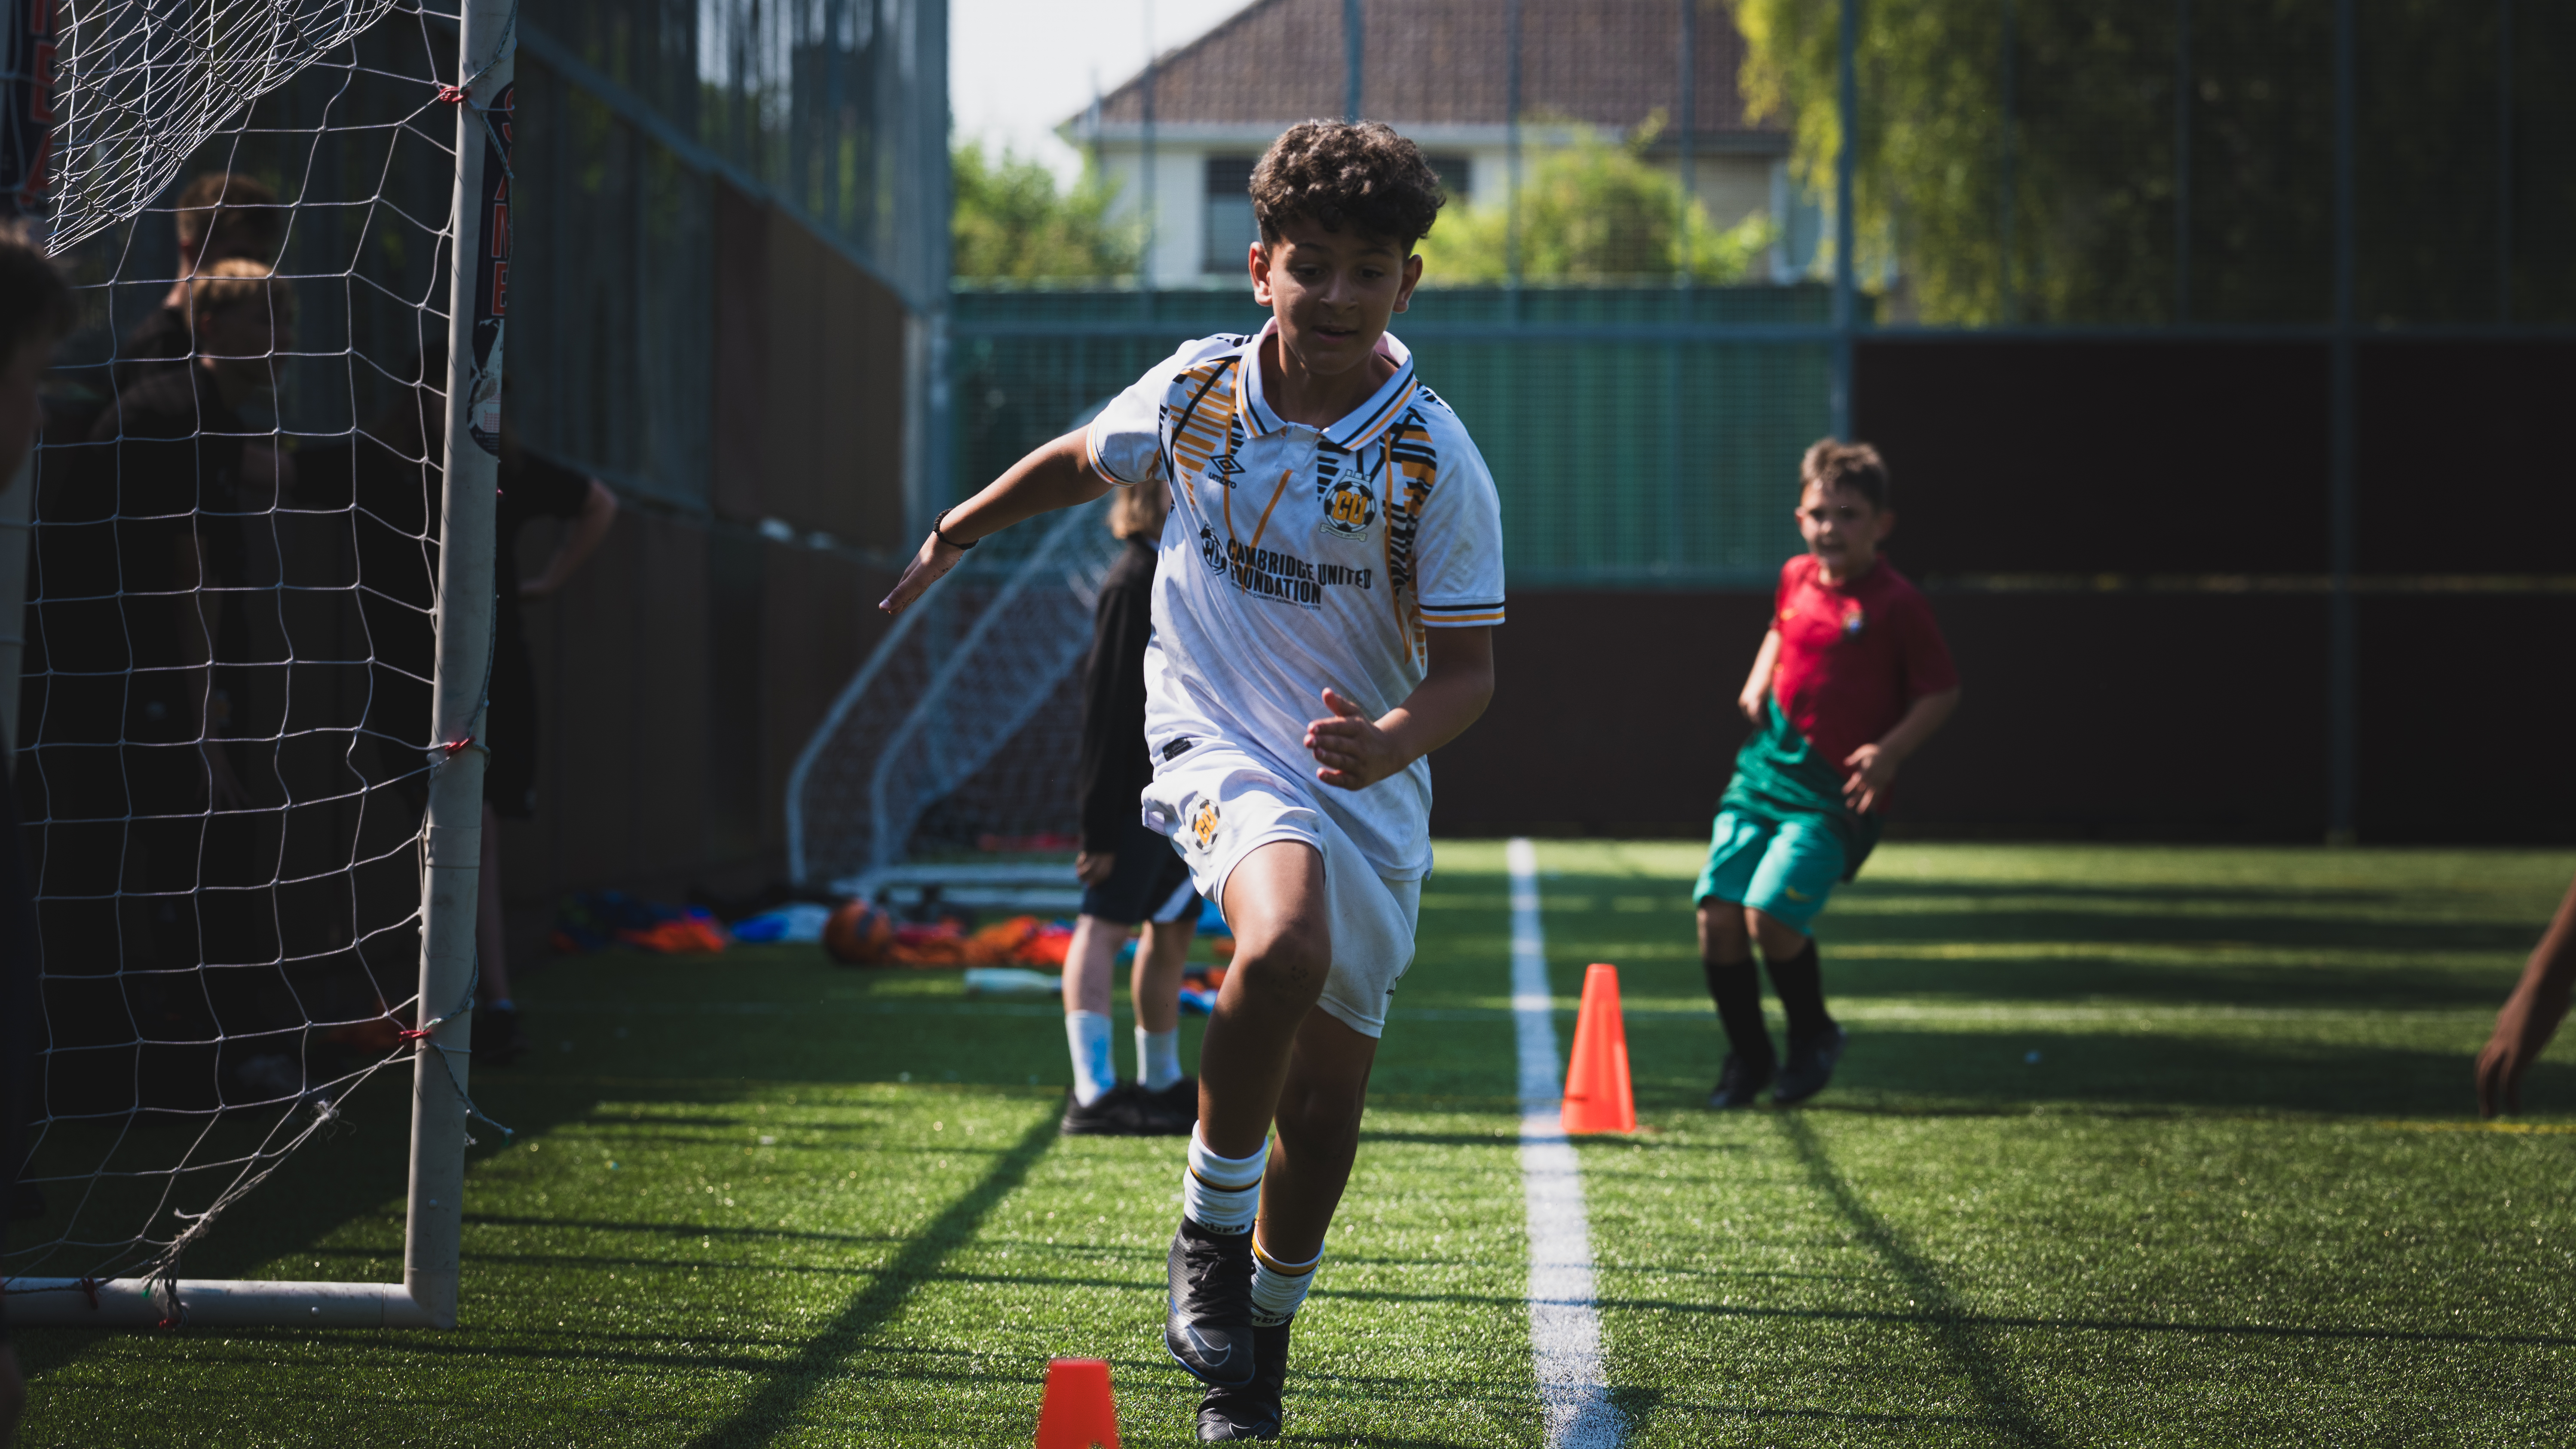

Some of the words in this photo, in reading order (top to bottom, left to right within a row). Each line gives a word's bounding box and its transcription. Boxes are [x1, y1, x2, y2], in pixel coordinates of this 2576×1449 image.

[1208, 472, 1237, 489] umbro
[1332, 490, 1368, 525] CU
[1227, 538, 1316, 581] CAMBRIDGE
[1317, 564, 1372, 590] UNITED
[1230, 561, 1321, 604] FOUNDATION
[1195, 804, 1217, 844] CU
